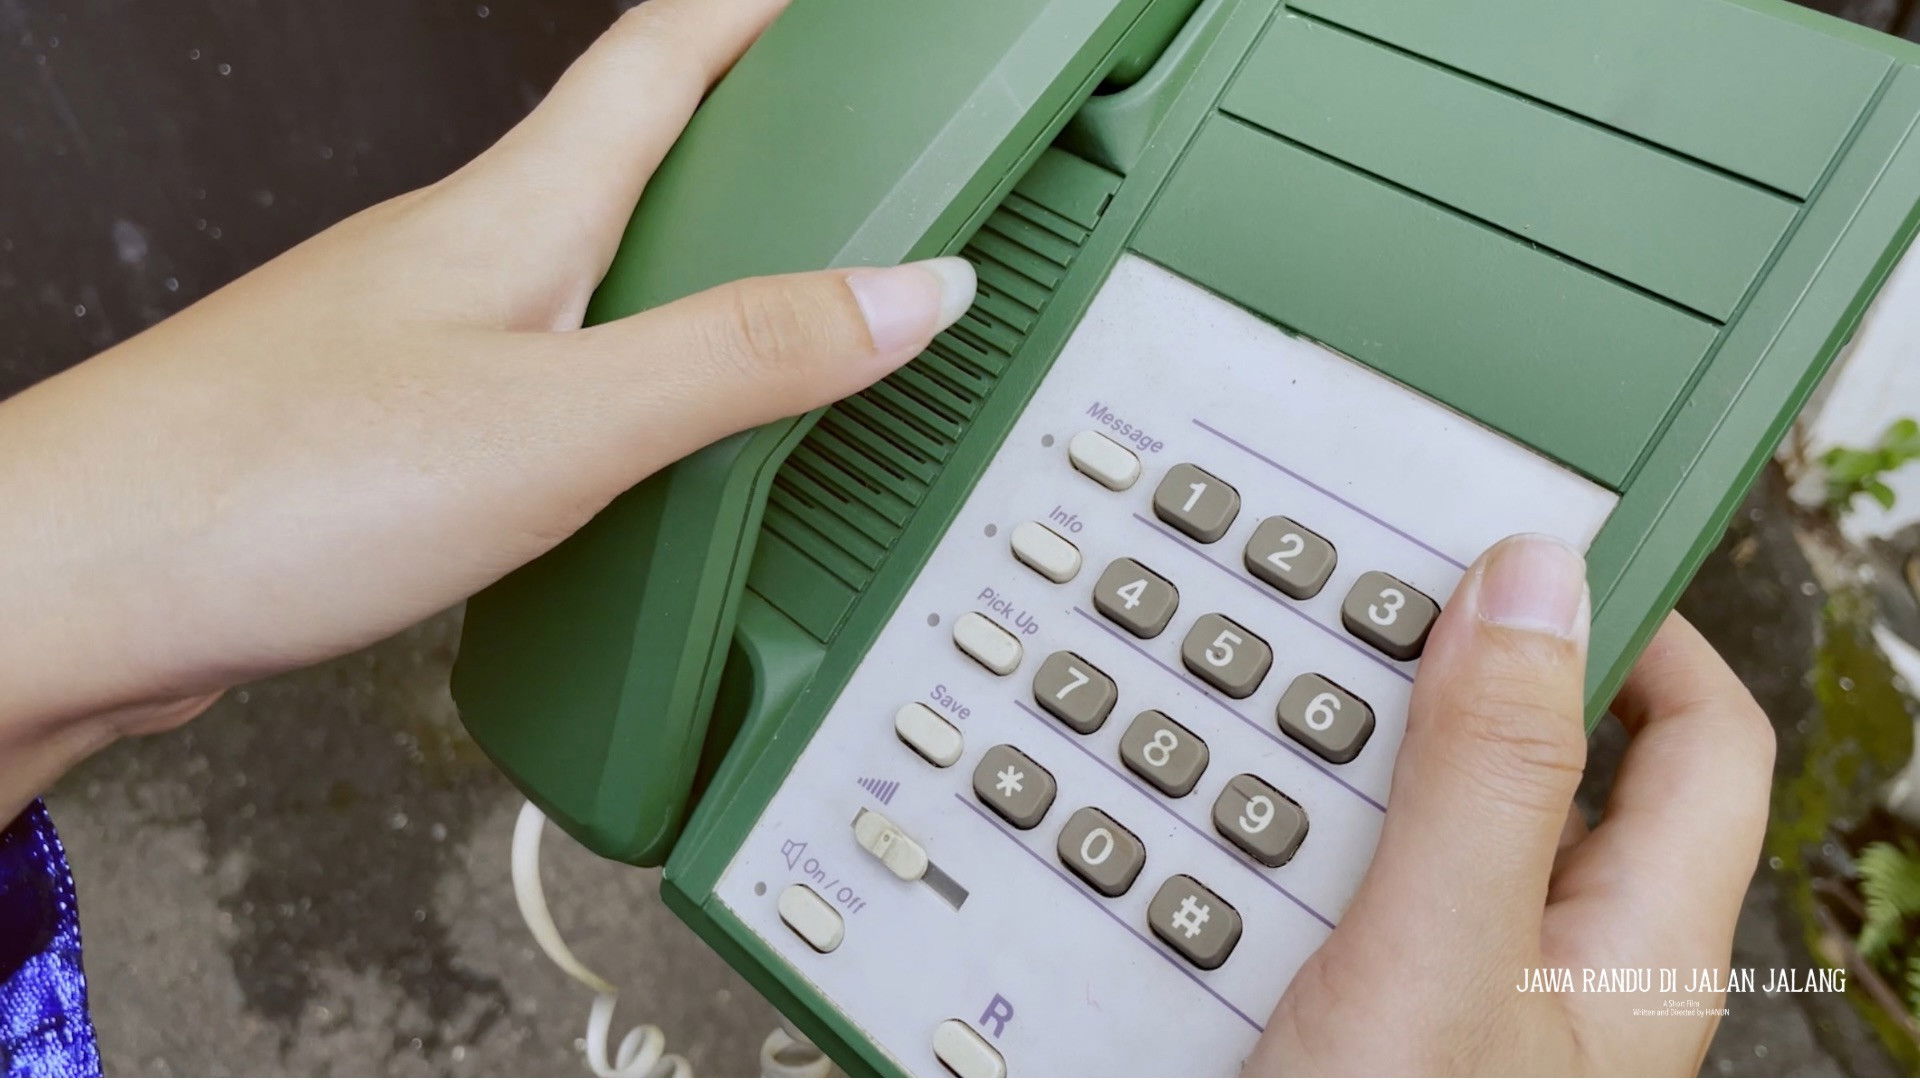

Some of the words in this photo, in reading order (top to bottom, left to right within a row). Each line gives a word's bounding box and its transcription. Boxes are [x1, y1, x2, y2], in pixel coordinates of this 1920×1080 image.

[1086, 402, 1164, 453] Message
[1050, 505, 1083, 534] Info
[1181, 482, 1207, 512] 1
[1267, 533, 1304, 572] 2
[1368, 588, 1405, 626] 3
[977, 587, 1014, 620] Pick
[1014, 610, 1039, 636] Up
[1116, 579, 1148, 610] 4
[1205, 629, 1242, 667] 5
[1304, 692, 1341, 731] 6
[930, 684, 971, 720] Save
[1056, 666, 1090, 700] 7
[1143, 729, 1178, 767] 8
[1238, 795, 1275, 834] 9
[803, 858, 826, 883] On
[836, 886, 867, 914] Off
[1080, 828, 1114, 864] 0
[1172, 895, 1210, 938] #
[979, 993, 1014, 1039] R
